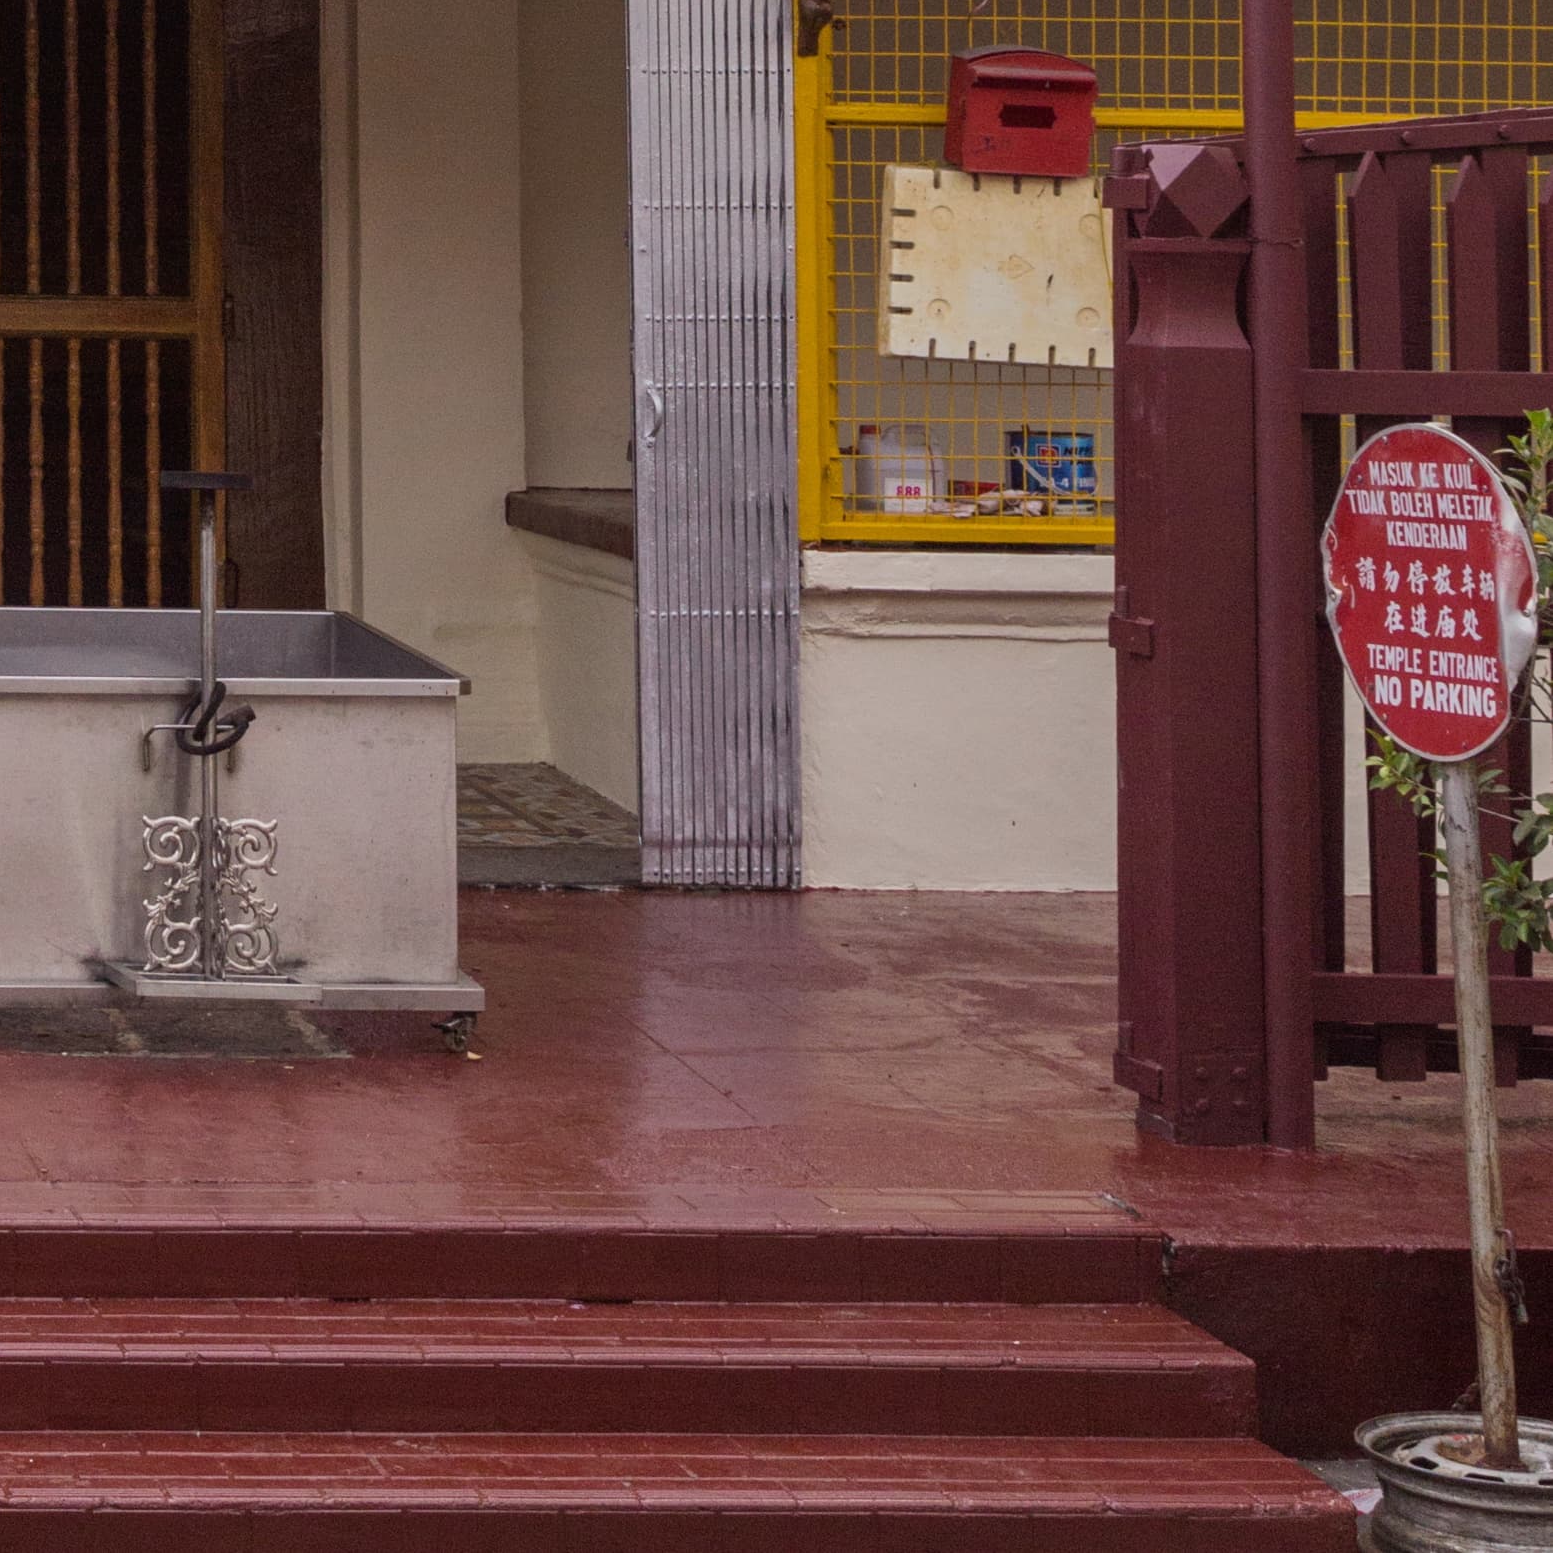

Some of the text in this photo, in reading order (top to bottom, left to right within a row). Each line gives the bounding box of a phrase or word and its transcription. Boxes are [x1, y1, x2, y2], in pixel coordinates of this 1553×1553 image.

[1368, 460, 1478, 491] MASUK KE KUIL
[1345, 489, 1494, 522] TIDAK BOLEH MELETAK
[1386, 521, 1467, 551] KENDERAAN
[1366, 643, 1499, 683] TEMPLE ENTRANCE
[1374, 674, 1497, 718] NO PARKING
